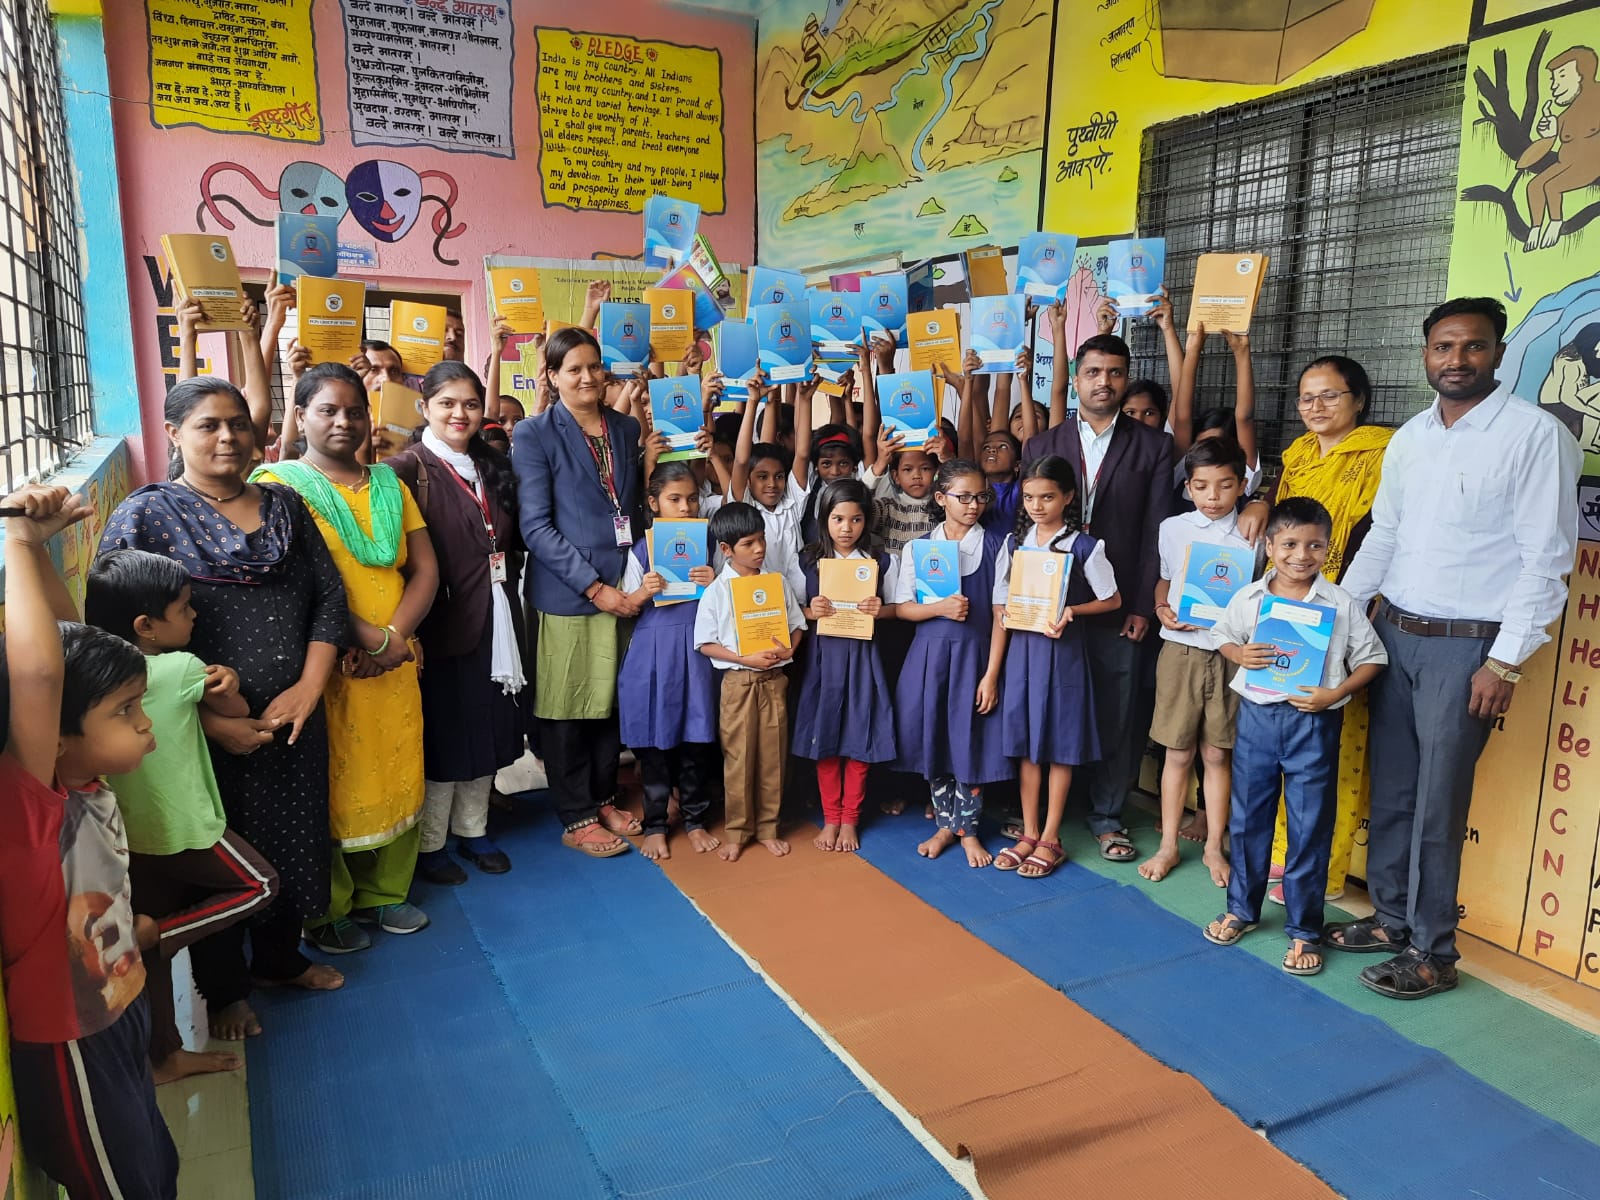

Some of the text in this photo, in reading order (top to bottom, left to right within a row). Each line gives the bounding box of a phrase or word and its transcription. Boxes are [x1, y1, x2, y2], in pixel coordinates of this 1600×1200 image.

[587, 37, 644, 64] PLEDGE
[542, 52, 566, 64] India
[572, 56, 580, 66] is
[586, 60, 600, 71] my
[645, 67, 656, 78] All
[662, 69, 693, 83] Indians
[542, 66, 559, 76] are
[564, 70, 578, 80] my
[583, 70, 622, 86] brothers
[628, 79, 645, 88] and
[554, 80, 560, 90] I
[564, 81, 581, 92] love
[584, 86, 599, 96] my
[652, 93, 657, 102] I
[660, 96, 672, 104] am
[676, 96, 700, 107] proud
[704, 100, 713, 110] of
[542, 104, 568, 116] strive
[571, 108, 580, 118] to
[583, 108, 594, 120] be
[596, 112, 626, 126] worthy
[630, 116, 639, 126] of
[556, 94, 573, 104] rich
[576, 98, 592, 106] and
[666, 107, 670, 116] I
[675, 109, 694, 119] shall
[696, 111, 720, 125] always
[544, 128, 554, 138] all
[558, 130, 584, 142] elders
[622, 138, 636, 148] and
[642, 141, 663, 152] treat
[666, 144, 700, 157] everyone
[554, 119, 560, 127] I
[565, 120, 585, 130] shall
[588, 123, 602, 133] give
[604, 126, 616, 136] my
[656, 130, 690, 144] teachers
[696, 135, 711, 145] and
[1066, 111, 1118, 156] पृथ्वीची
[550, 169, 564, 180] my
[608, 174, 618, 182] In
[624, 174, 644, 184] their
[563, 157, 572, 166] To
[576, 160, 588, 170] my
[592, 160, 624, 172] country
[627, 162, 642, 172] and
[644, 166, 656, 176] my
[691, 168, 696, 178] I
[700, 170, 720, 184] pledge
[550, 182, 566, 190] and
[573, 184, 620, 198] prosperity
[624, 188, 646, 196] alone
[567, 196, 582, 207] my
[1578, 594, 1600, 621] H
[1562, 680, 1590, 708] Li
[1557, 722, 1590, 758] Be
[1552, 763, 1571, 792] B
[1550, 808, 1568, 835] C
[1542, 848, 1564, 877] N
[1540, 892, 1560, 917] O
